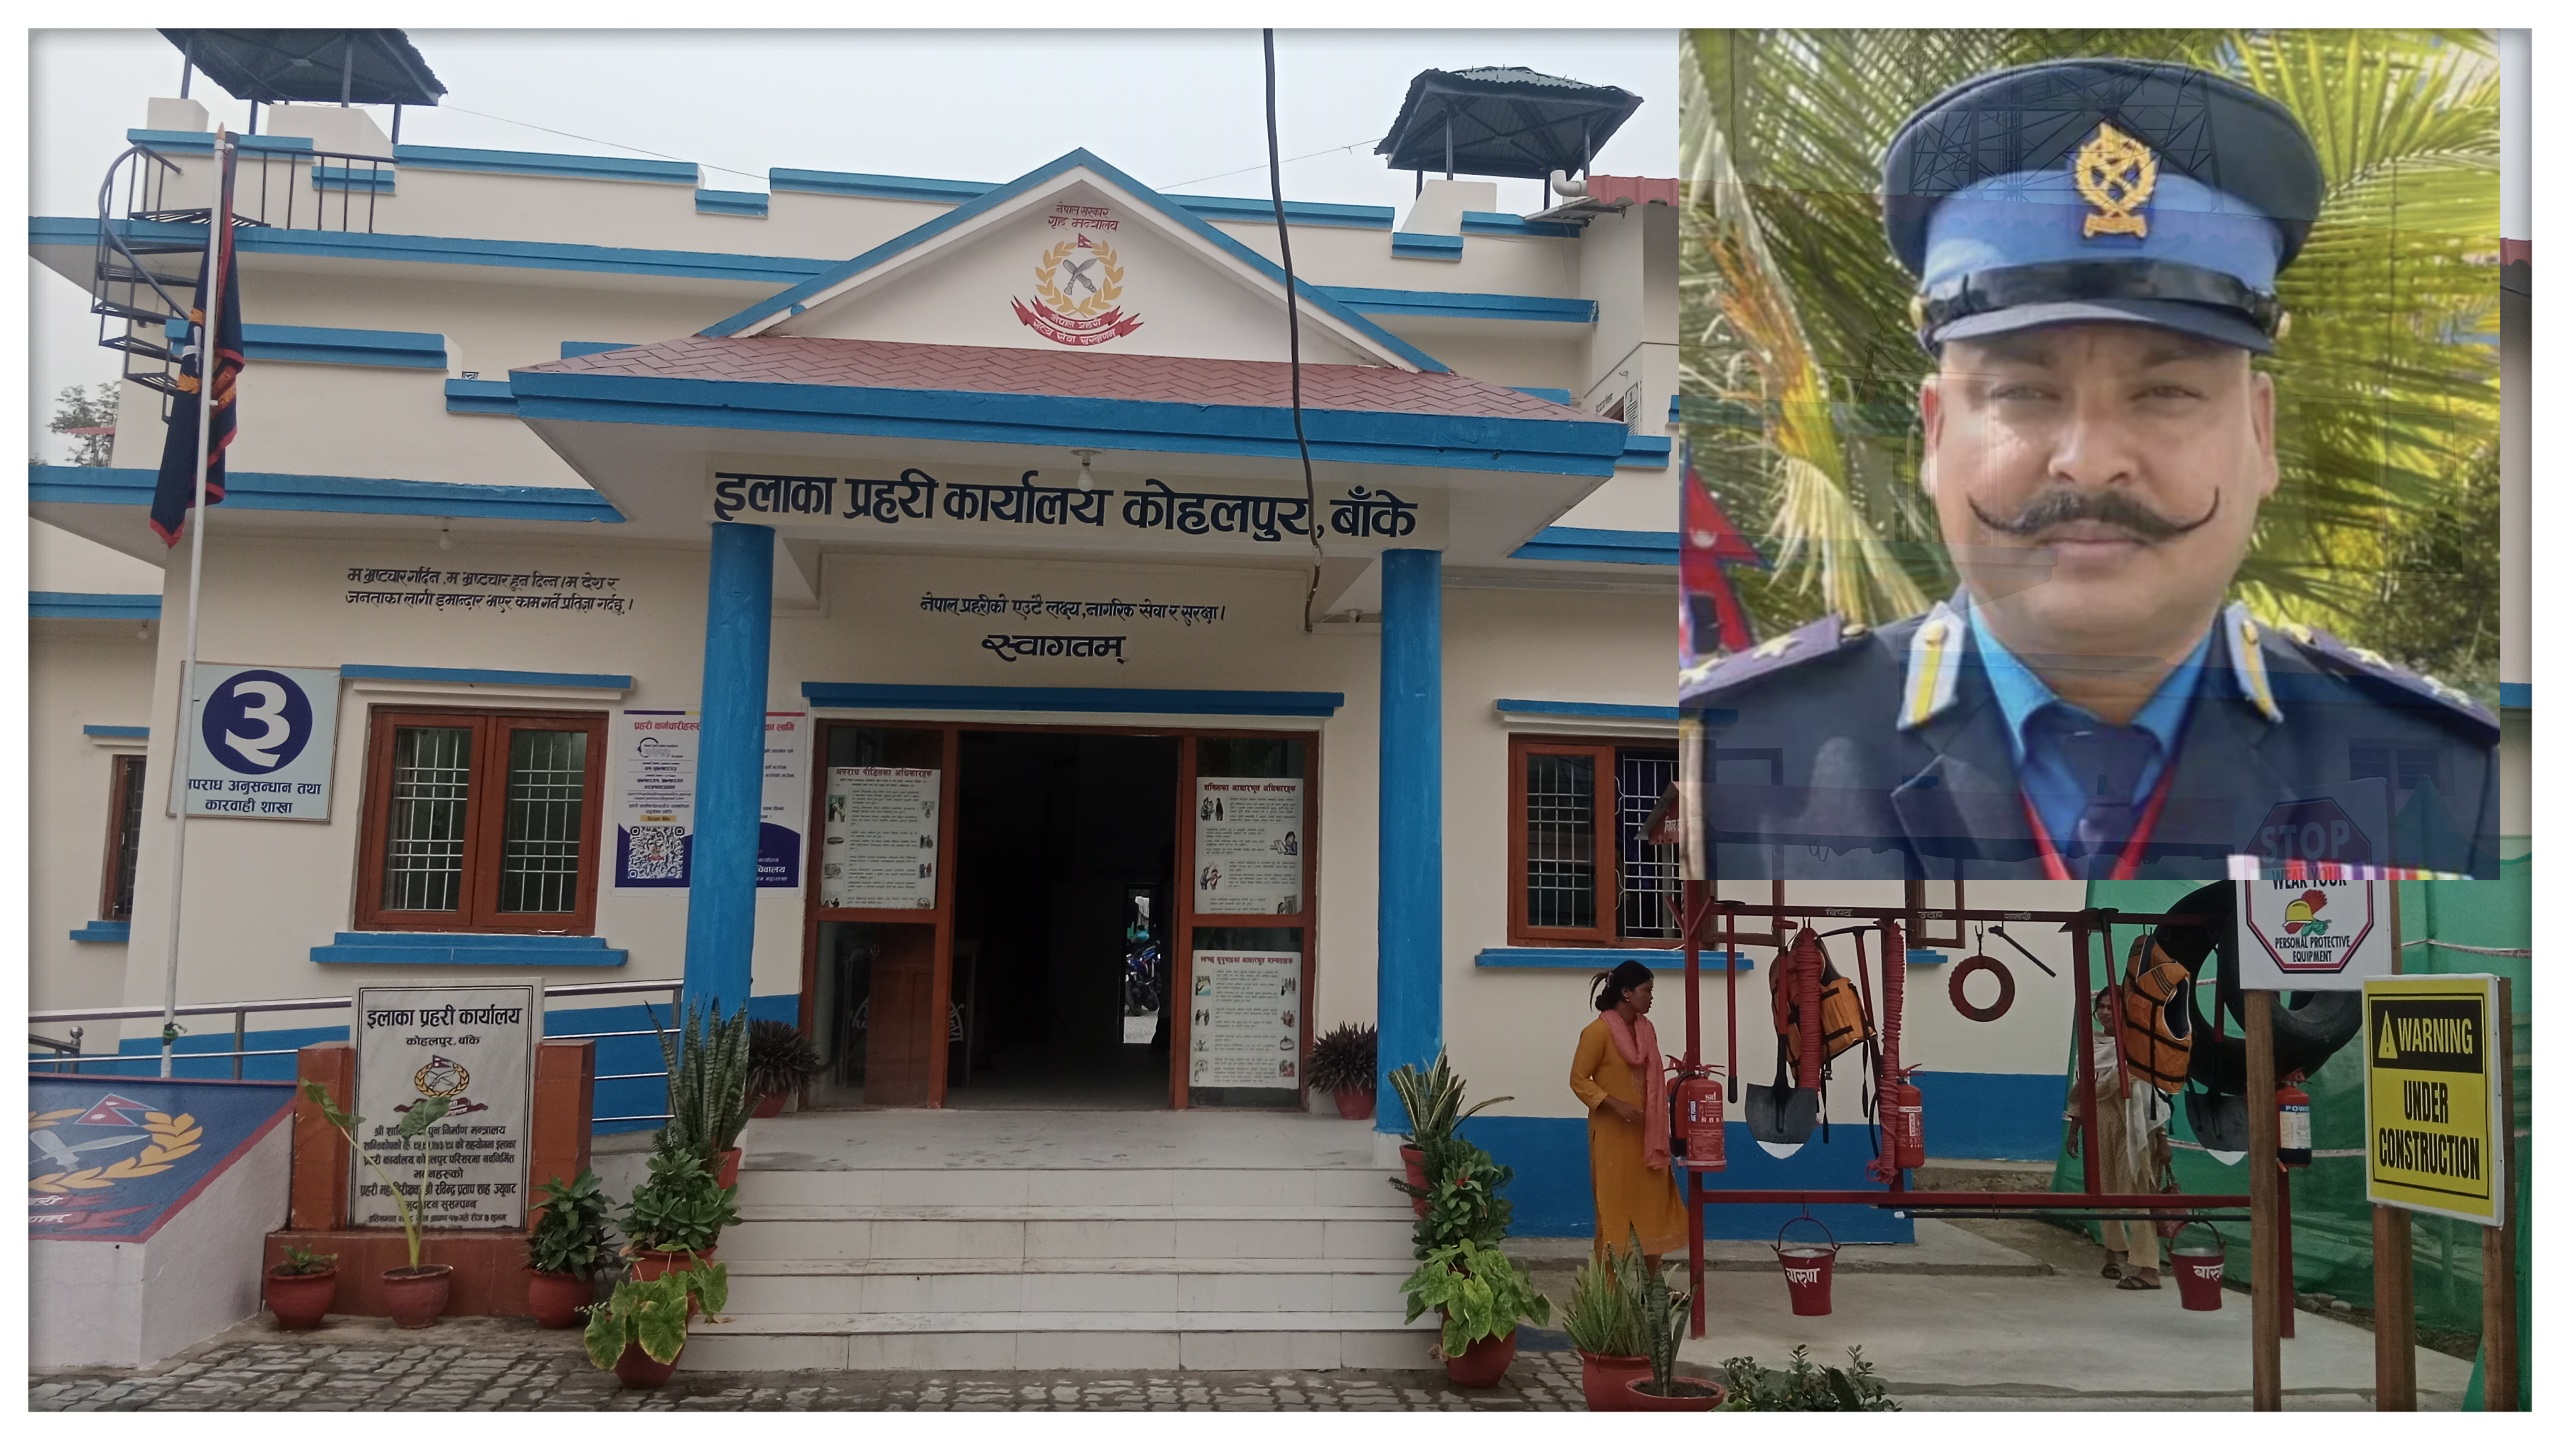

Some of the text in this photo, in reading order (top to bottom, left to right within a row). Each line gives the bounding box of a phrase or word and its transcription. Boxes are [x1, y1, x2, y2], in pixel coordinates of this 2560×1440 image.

[1056, 201, 1110, 219] नेपाल सरकार
[1048, 215, 1120, 234] गृह मन्त्रालय
[714, 471, 838, 522] इलाका
[843, 468, 939, 524] प्रहरी
[943, 470, 1115, 527] कार्यालय
[1329, 485, 1419, 538] बाँके
[347, 567, 363, 583] म
[607, 577, 620, 591] र
[345, 590, 404, 607] जनताका
[486, 593, 515, 613] भएर
[515, 595, 541, 609] काम
[920, 591, 960, 616] नेपाल
[959, 593, 1009, 617] प्रहरीको
[1011, 594, 1044, 620] एउटै
[1139, 598, 1169, 620] सेवा
[1169, 605, 1181, 621] र
[1181, 605, 1220, 627] सुरक्षा
[981, 634, 1127, 665] स्वागतम्
[224, 680, 291, 768] ३
[228, 780, 293, 796] अनुसन्धान
[297, 783, 322, 795] तथा
[205, 797, 293, 814] कारवाही शाखा
[2260, 820, 2350, 863] STOP
[2272, 867, 2347, 890] WEAR YOUR
[2275, 935, 2350, 949] PERSONAL PROTECTIVE
[2292, 950, 2332, 962] EQUIPMENT
[366, 1004, 523, 1029] इलाका प्रहरी कार्यालय
[2397, 1017, 2473, 1055] WARNING
[2403, 1079, 2449, 1124] UNDER
[374, 1124, 384, 1137] श्री
[470, 1126, 507, 1137] मन्त्रालय
[495, 1140, 517, 1151] इलाका
[2378, 1126, 2481, 1181] CONSTRUCTION
[416, 1153, 447, 1167] कोलपुर
[360, 1182, 378, 1197] प्रहरी
[457, 1183, 476, 1197] प्रताप
[476, 1183, 491, 1195] शाह
